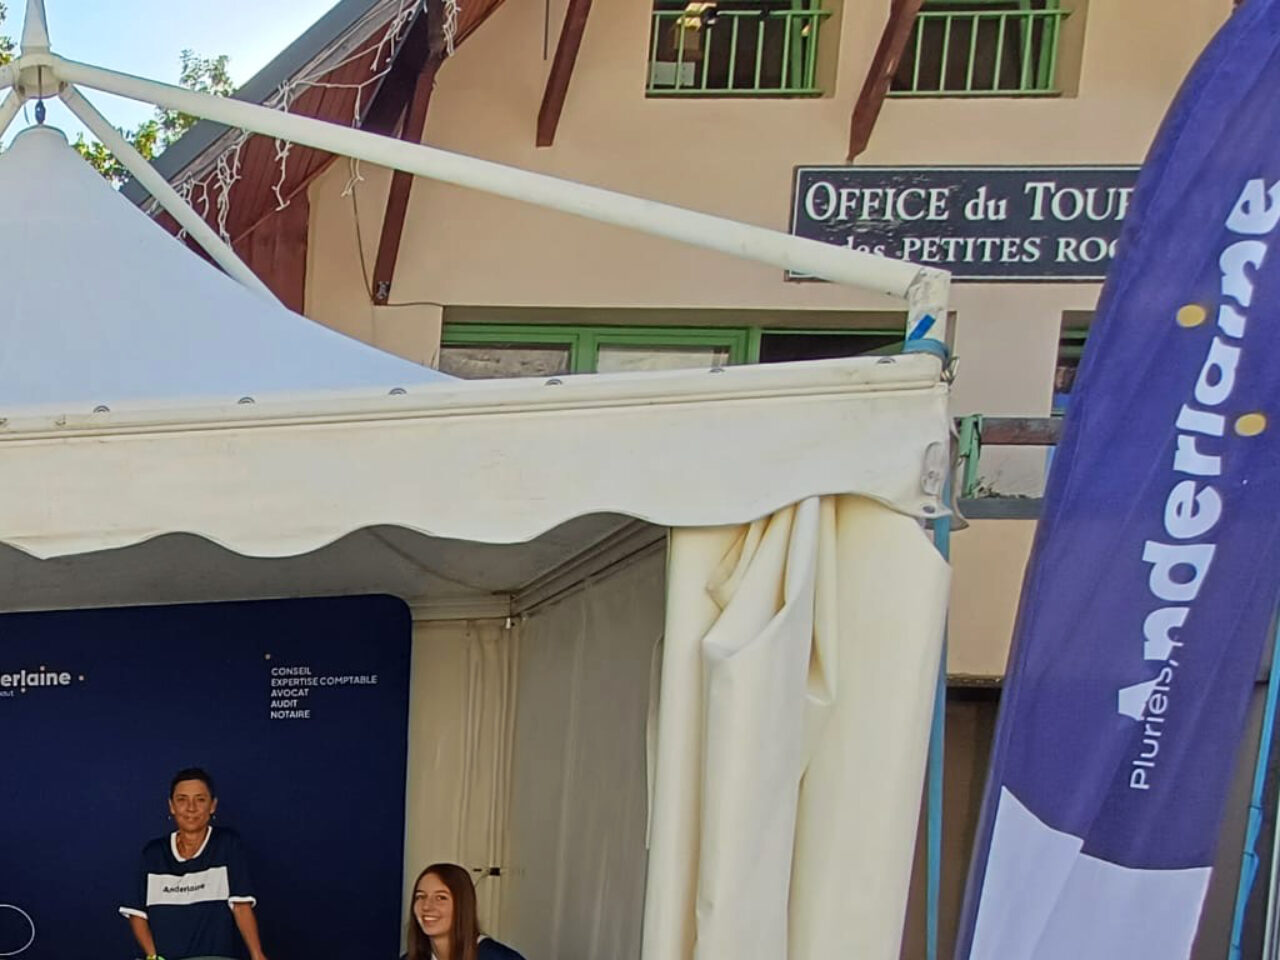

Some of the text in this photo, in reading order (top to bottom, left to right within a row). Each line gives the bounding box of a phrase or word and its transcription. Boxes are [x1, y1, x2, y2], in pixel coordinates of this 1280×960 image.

[805, 181, 950, 221] OFFICE
[965, 186, 1007, 221] du
[902, 236, 1041, 262] PETITES
[271, 667, 312, 676] CONSEIL
[271, 675, 378, 686] EXPERTISE COMPTABLE
[271, 688, 310, 697] AVOCAT
[270, 699, 298, 708] AUDIT
[270, 709, 311, 719] NOTAIRE
